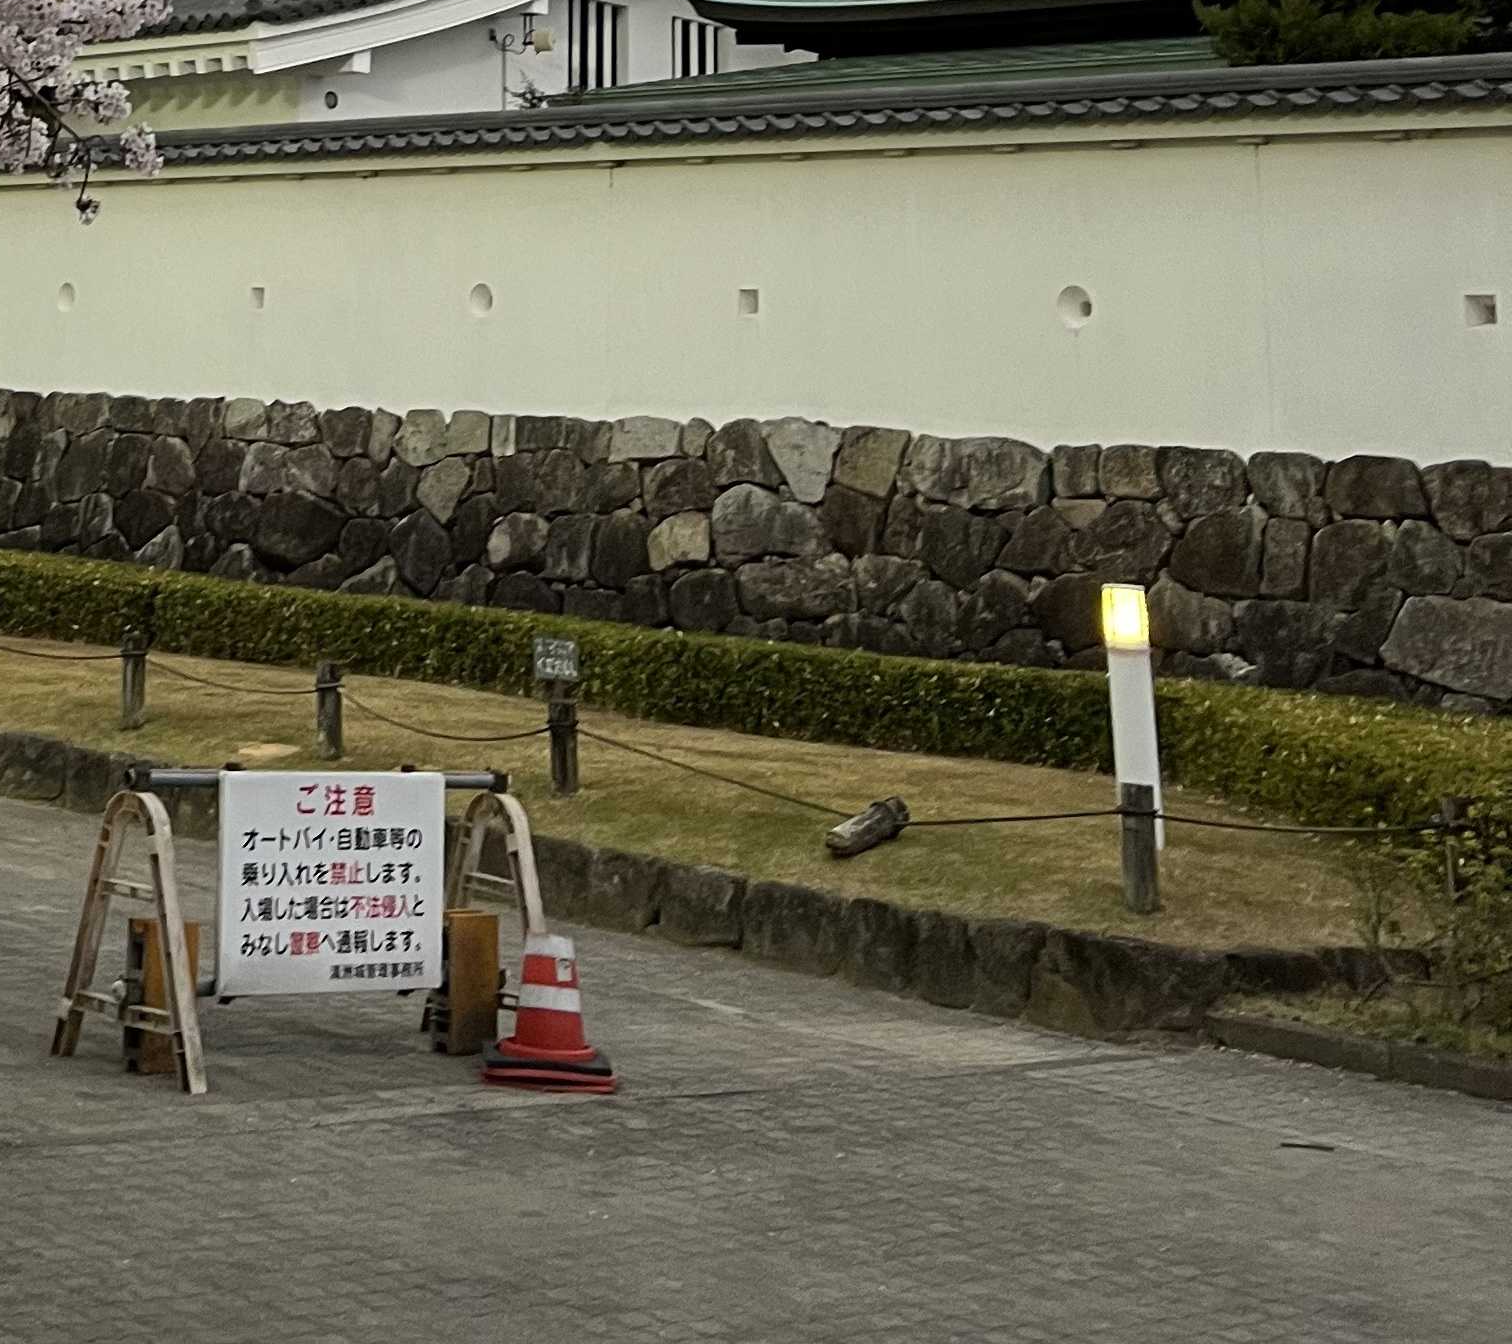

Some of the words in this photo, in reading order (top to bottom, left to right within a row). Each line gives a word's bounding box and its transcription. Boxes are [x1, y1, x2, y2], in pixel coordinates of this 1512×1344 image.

[297, 783, 376, 816] ご注意
[242, 826, 423, 851] オートバイ・自動車等の
[241, 862, 422, 887] 乗り入れを禁止します。
[241, 894, 425, 922] 入場した場合は不法侵入と
[241, 929, 422, 957] みなし警察へ通報します。
